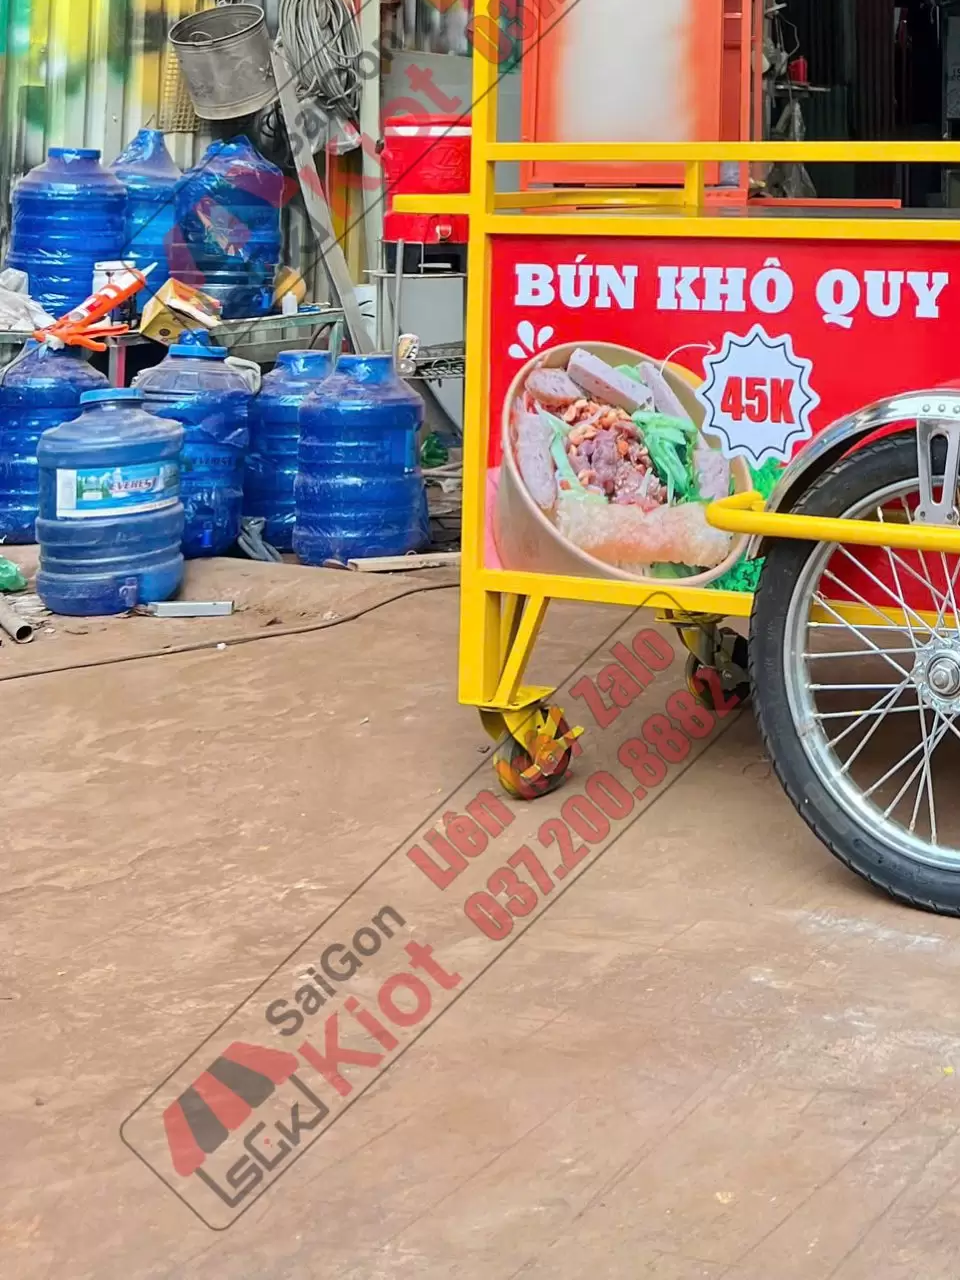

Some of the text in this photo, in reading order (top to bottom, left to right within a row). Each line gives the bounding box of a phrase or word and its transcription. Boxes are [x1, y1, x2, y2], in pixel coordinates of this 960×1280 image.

[513, 254, 638, 311] BÚN
[656, 257, 794, 315] KHÔ
[815, 268, 957, 328] QUY
[720, 376, 796, 424] 45K
